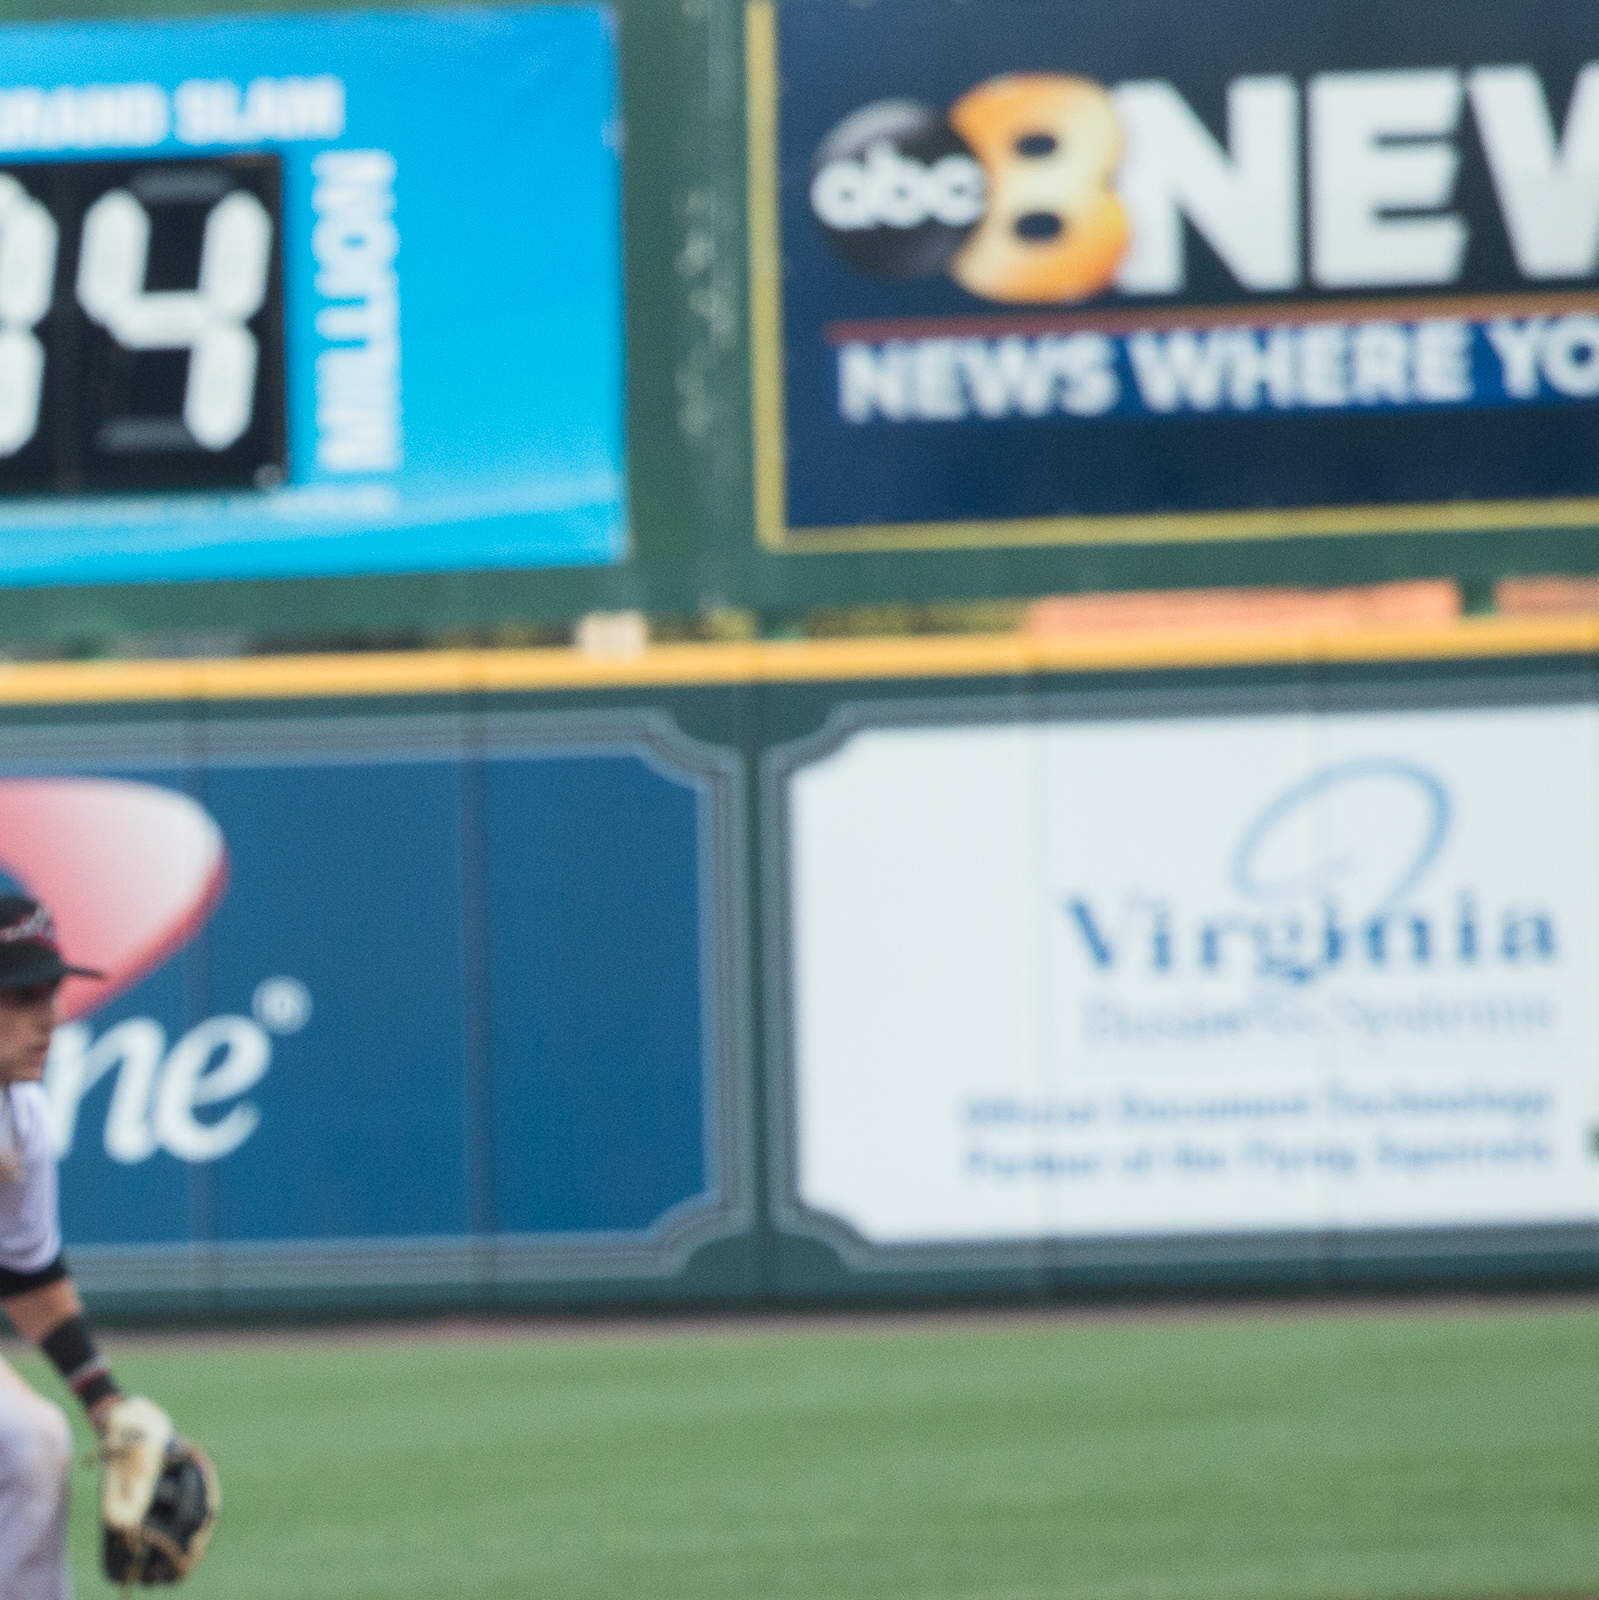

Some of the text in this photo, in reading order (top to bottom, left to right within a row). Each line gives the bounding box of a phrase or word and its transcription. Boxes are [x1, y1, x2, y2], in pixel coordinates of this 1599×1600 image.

[174, 77, 344, 143] SLAM
[813, 143, 991, 229] abc
[313, 150, 400, 474] MILLION
[841, 330, 1119, 421] NEWS
[1127, 322, 1477, 410] WHERE
[1068, 893, 1559, 986] Virginia
